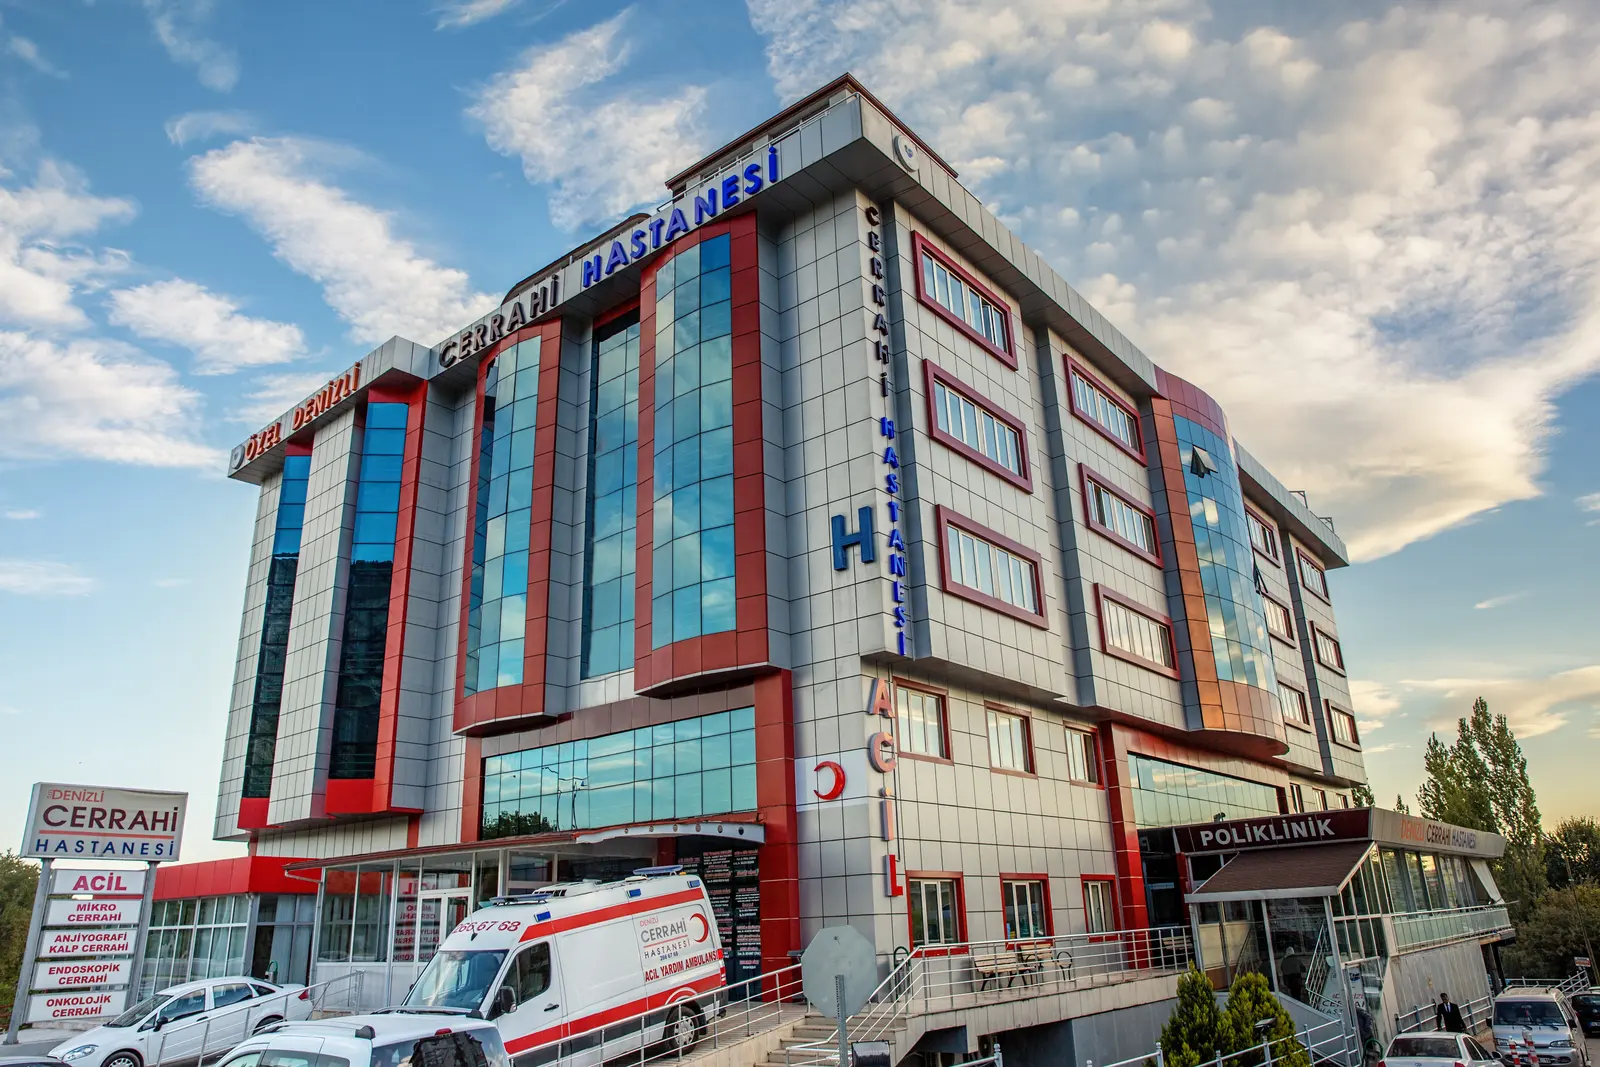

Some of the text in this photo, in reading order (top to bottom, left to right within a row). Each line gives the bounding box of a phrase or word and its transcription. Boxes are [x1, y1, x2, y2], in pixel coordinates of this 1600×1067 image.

[438, 145, 779, 369] CERRAHİ HASTANESİ
[865, 206, 889, 398] CERRAHİ
[244, 361, 361, 461] ÖZEL DENİZLİ
[831, 505, 875, 571] H
[51, 788, 105, 803] DENİZLİ
[868, 677, 904, 897] ACİL
[43, 804, 179, 832] CERRAHİ
[1199, 816, 1336, 847] POLİKLİNİK
[35, 838, 175, 856] HASTANESİ
[72, 872, 128, 891] ACİL
[76, 902, 117, 912] MİKRO
[67, 912, 122, 922] CERRAHİ
[477, 920, 499, 931] 67
[497, 920, 521, 932] 68
[641, 917, 687, 943] CERRAHİ
[54, 932, 127, 943] ANJİYOGRAFİ
[49, 942, 129, 953] KALP CERRAHİ
[48, 963, 120, 975] ENDOSKOPİK
[660, 960, 685, 977] YARDIM
[58, 973, 108, 985] CERRAHİ
[46, 994, 112, 1007] ONKOLOJİK
[52, 1005, 102, 1018] CERRAHİ
